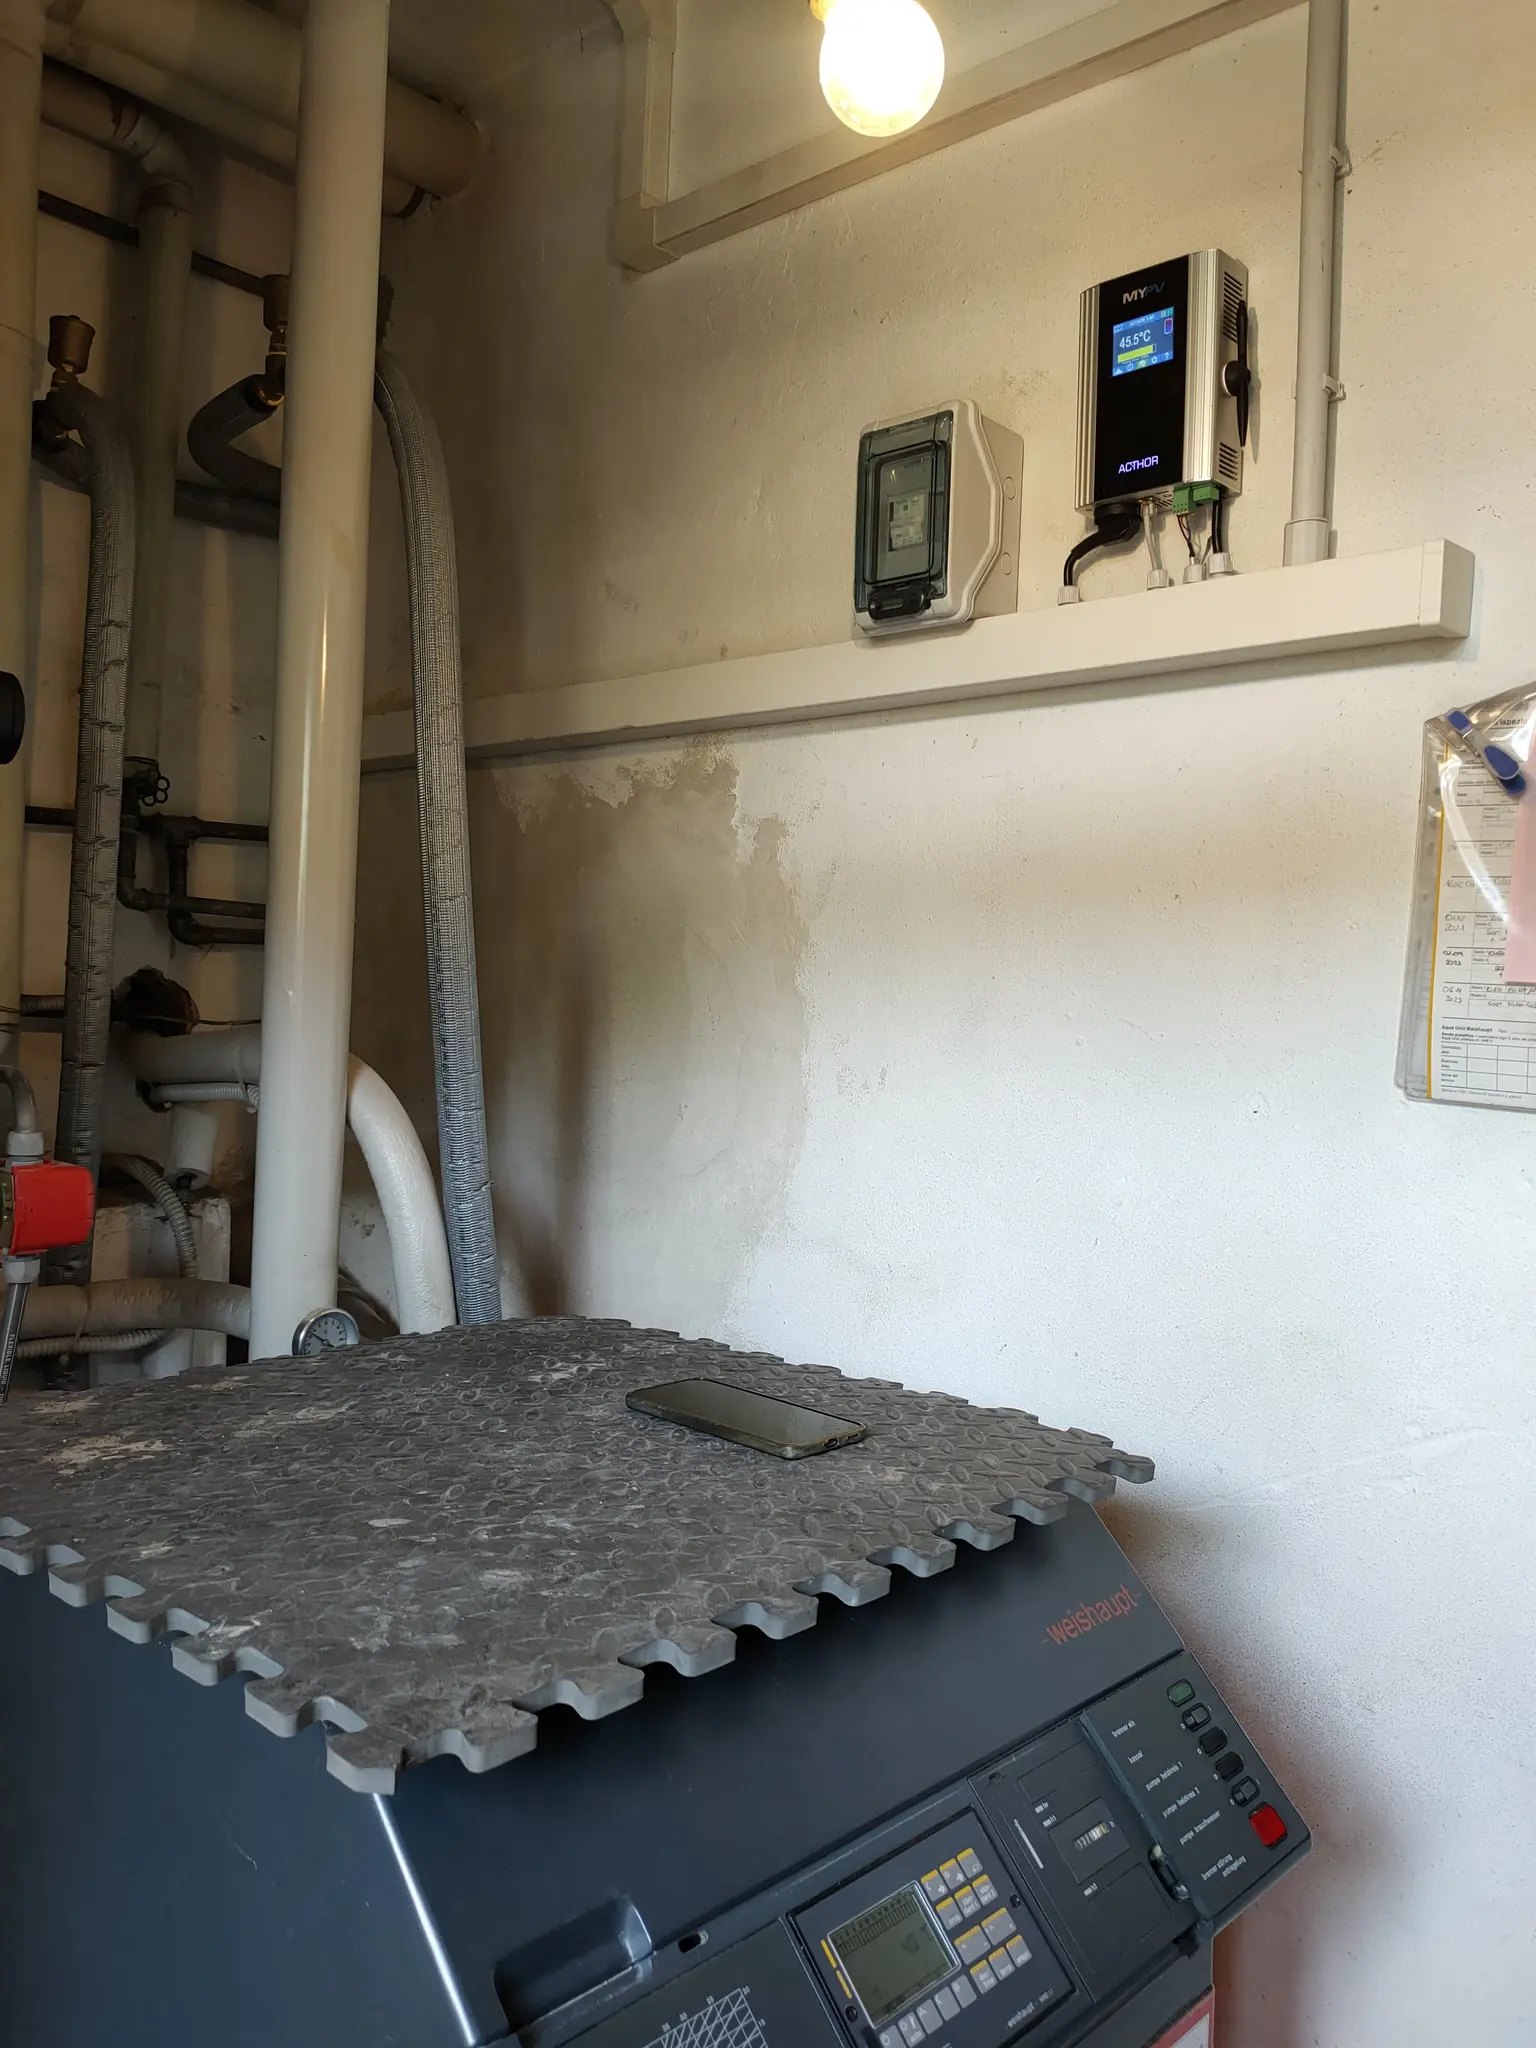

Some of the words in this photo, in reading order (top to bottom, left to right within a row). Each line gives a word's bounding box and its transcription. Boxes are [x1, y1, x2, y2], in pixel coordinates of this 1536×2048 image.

[1119, 329, 1151, 349] 45.5°C
[1118, 455, 1159, 475] ACTHOR
[1145, 1777, 1161, 1792] pumpe
[1179, 1830, 1195, 1845] pumpe
